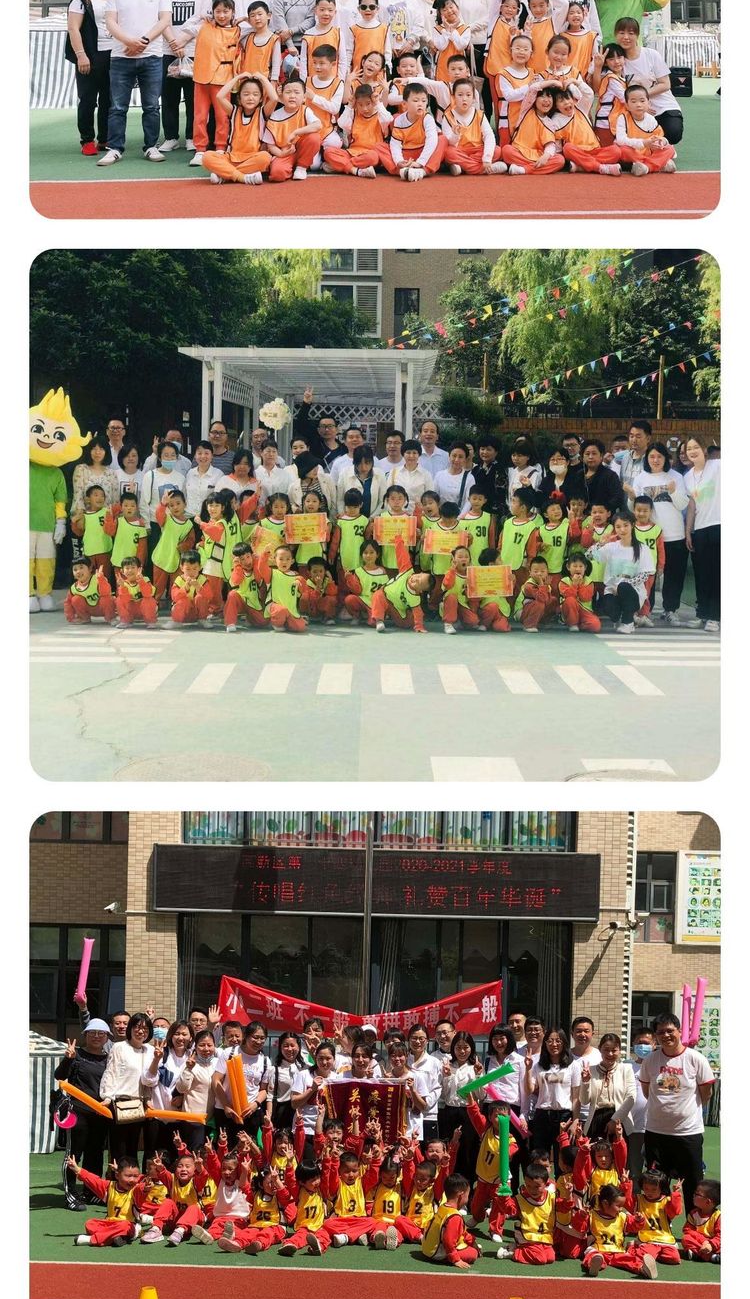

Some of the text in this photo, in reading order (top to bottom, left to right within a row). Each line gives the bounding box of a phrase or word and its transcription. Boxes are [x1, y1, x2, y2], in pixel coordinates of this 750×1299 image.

[229, 523, 238, 536] 27
[354, 525, 364, 536] 23
[476, 526, 486, 536] 30
[514, 532, 524, 544] 17
[552, 536, 562, 546] 16
[226, 987, 284, 1021] 小二班
[484, 1150, 494, 1165] 11
[114, 1206, 121, 1218] 7
[349, 1200, 356, 1212] 3
[382, 1200, 394, 1214] 19
[415, 1202, 422, 1214] 2
[304, 1206, 318, 1219] 17
